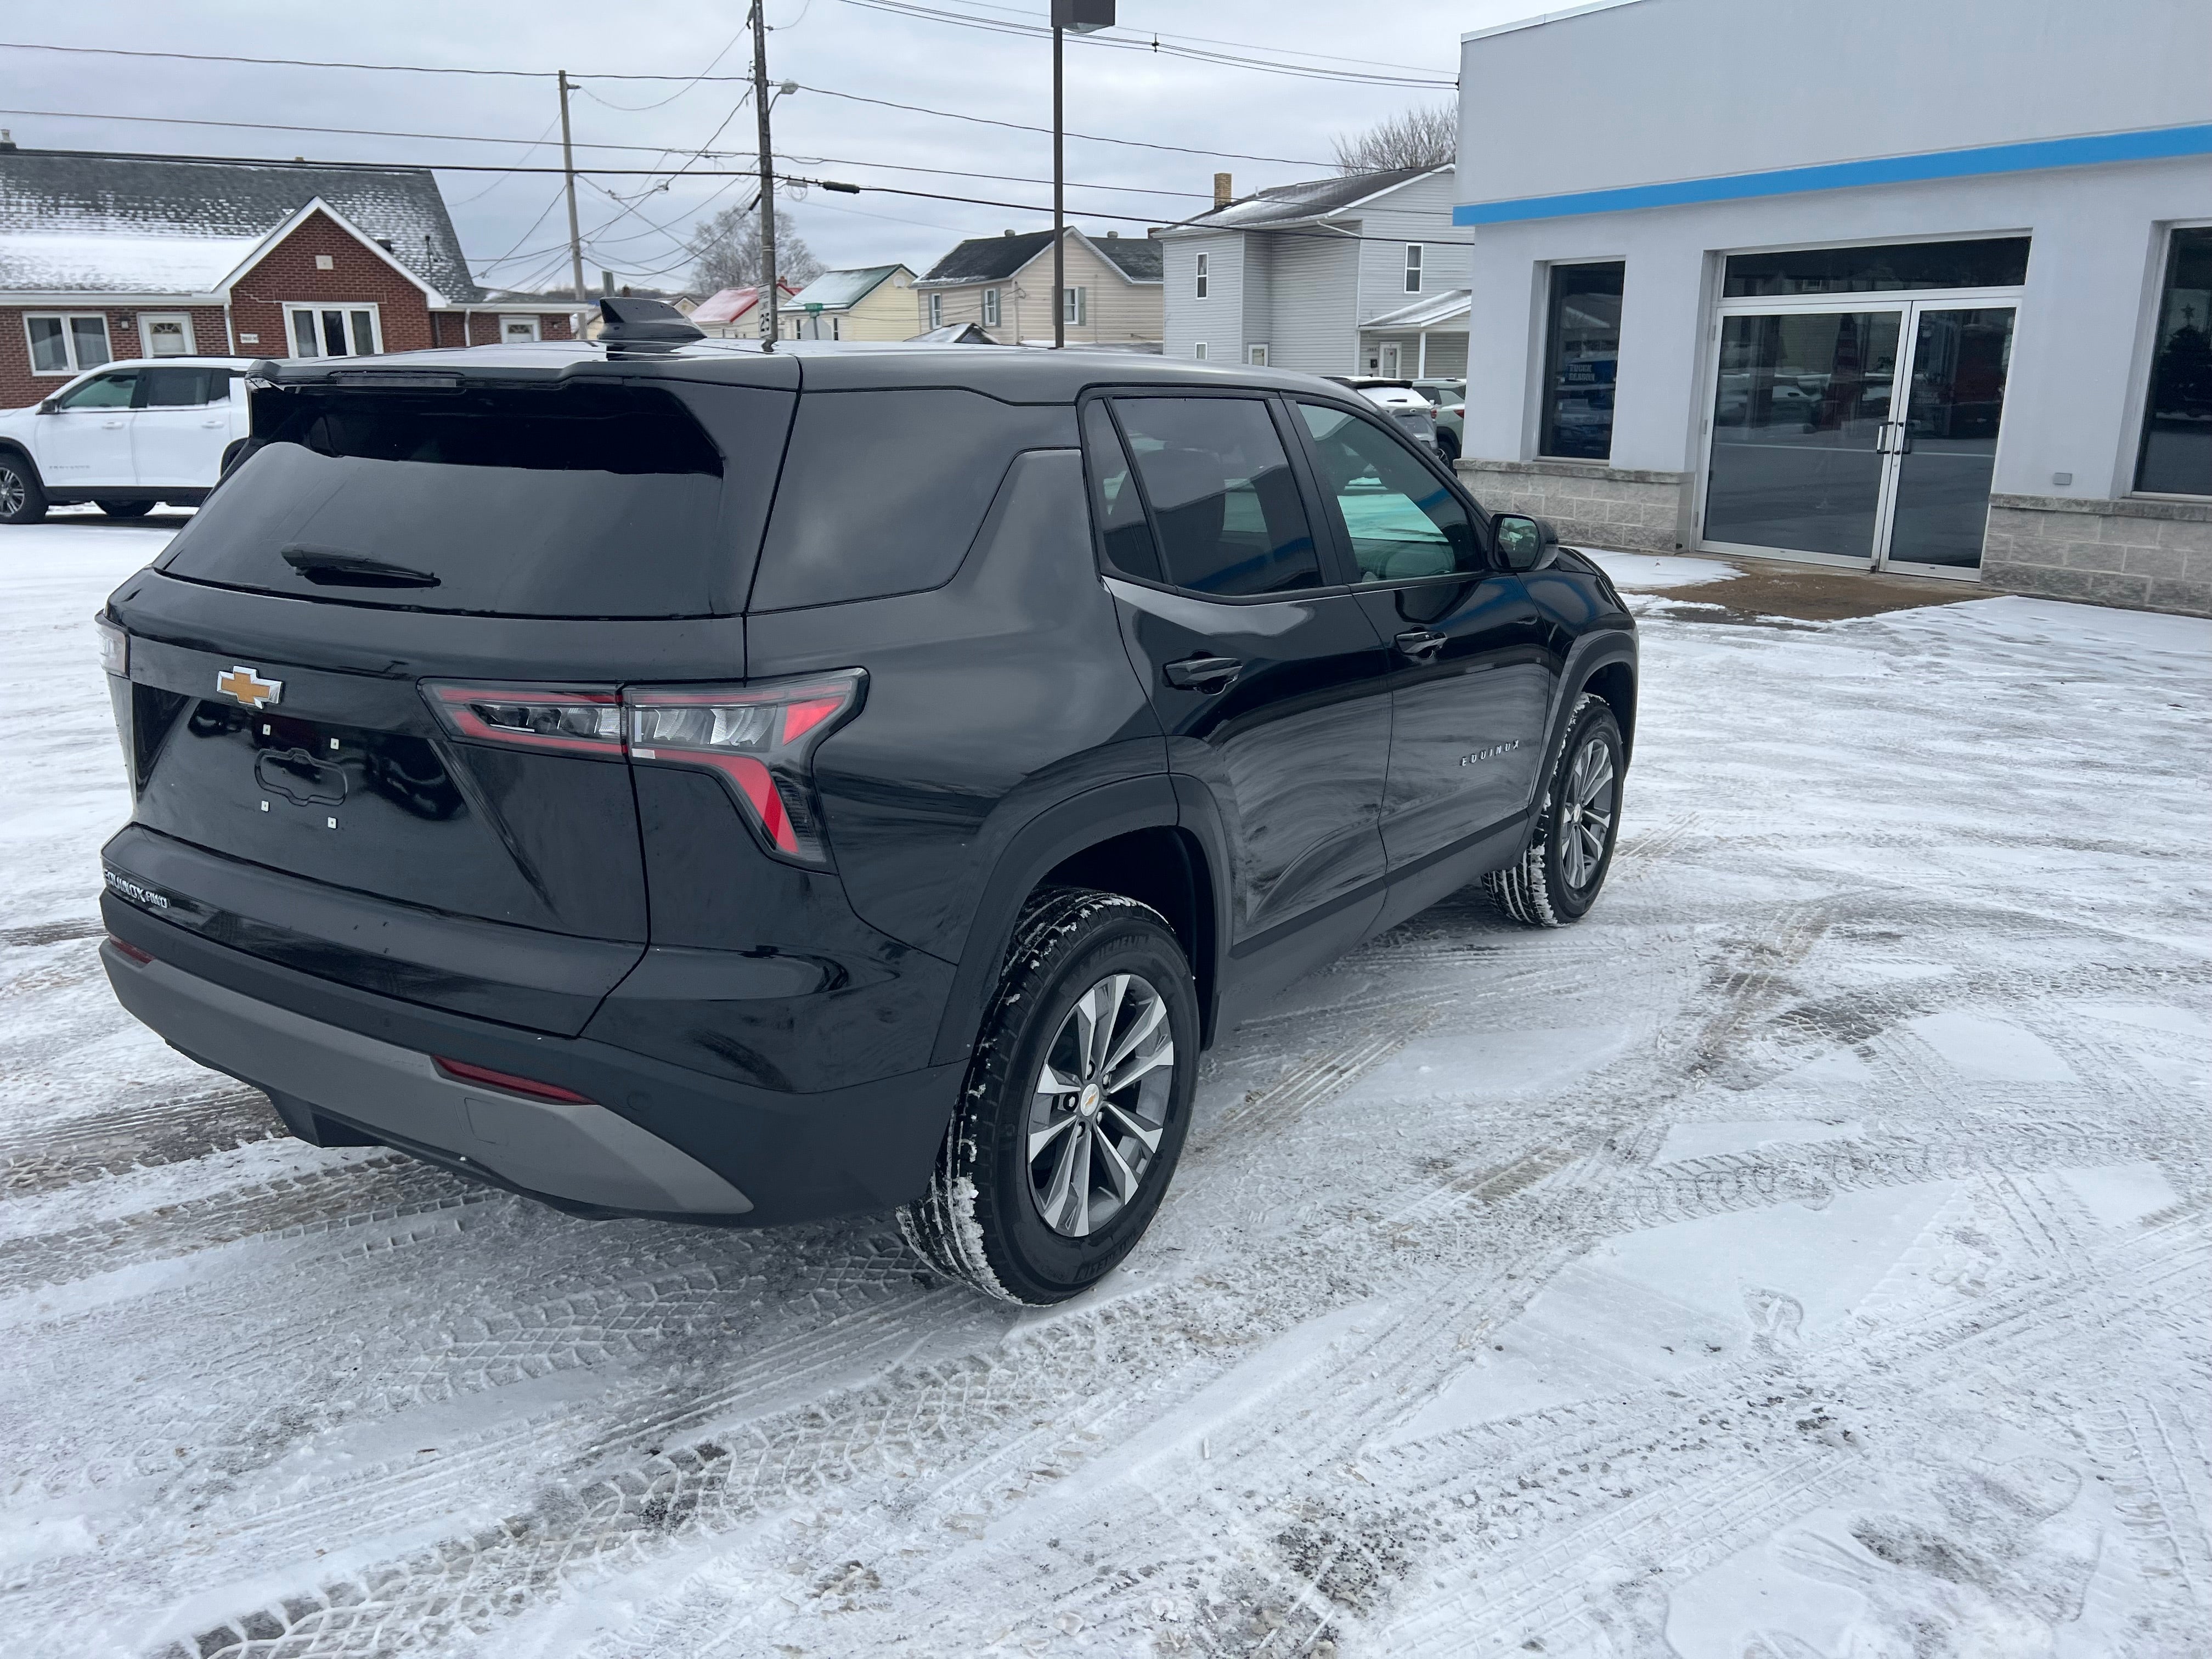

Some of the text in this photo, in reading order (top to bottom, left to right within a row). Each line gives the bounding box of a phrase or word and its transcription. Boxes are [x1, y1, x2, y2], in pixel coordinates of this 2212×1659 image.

[760, 313, 770, 332] 25
[1460, 739, 1519, 766] EQUINOX
[104, 869, 168, 909] EQUINOX AWD
